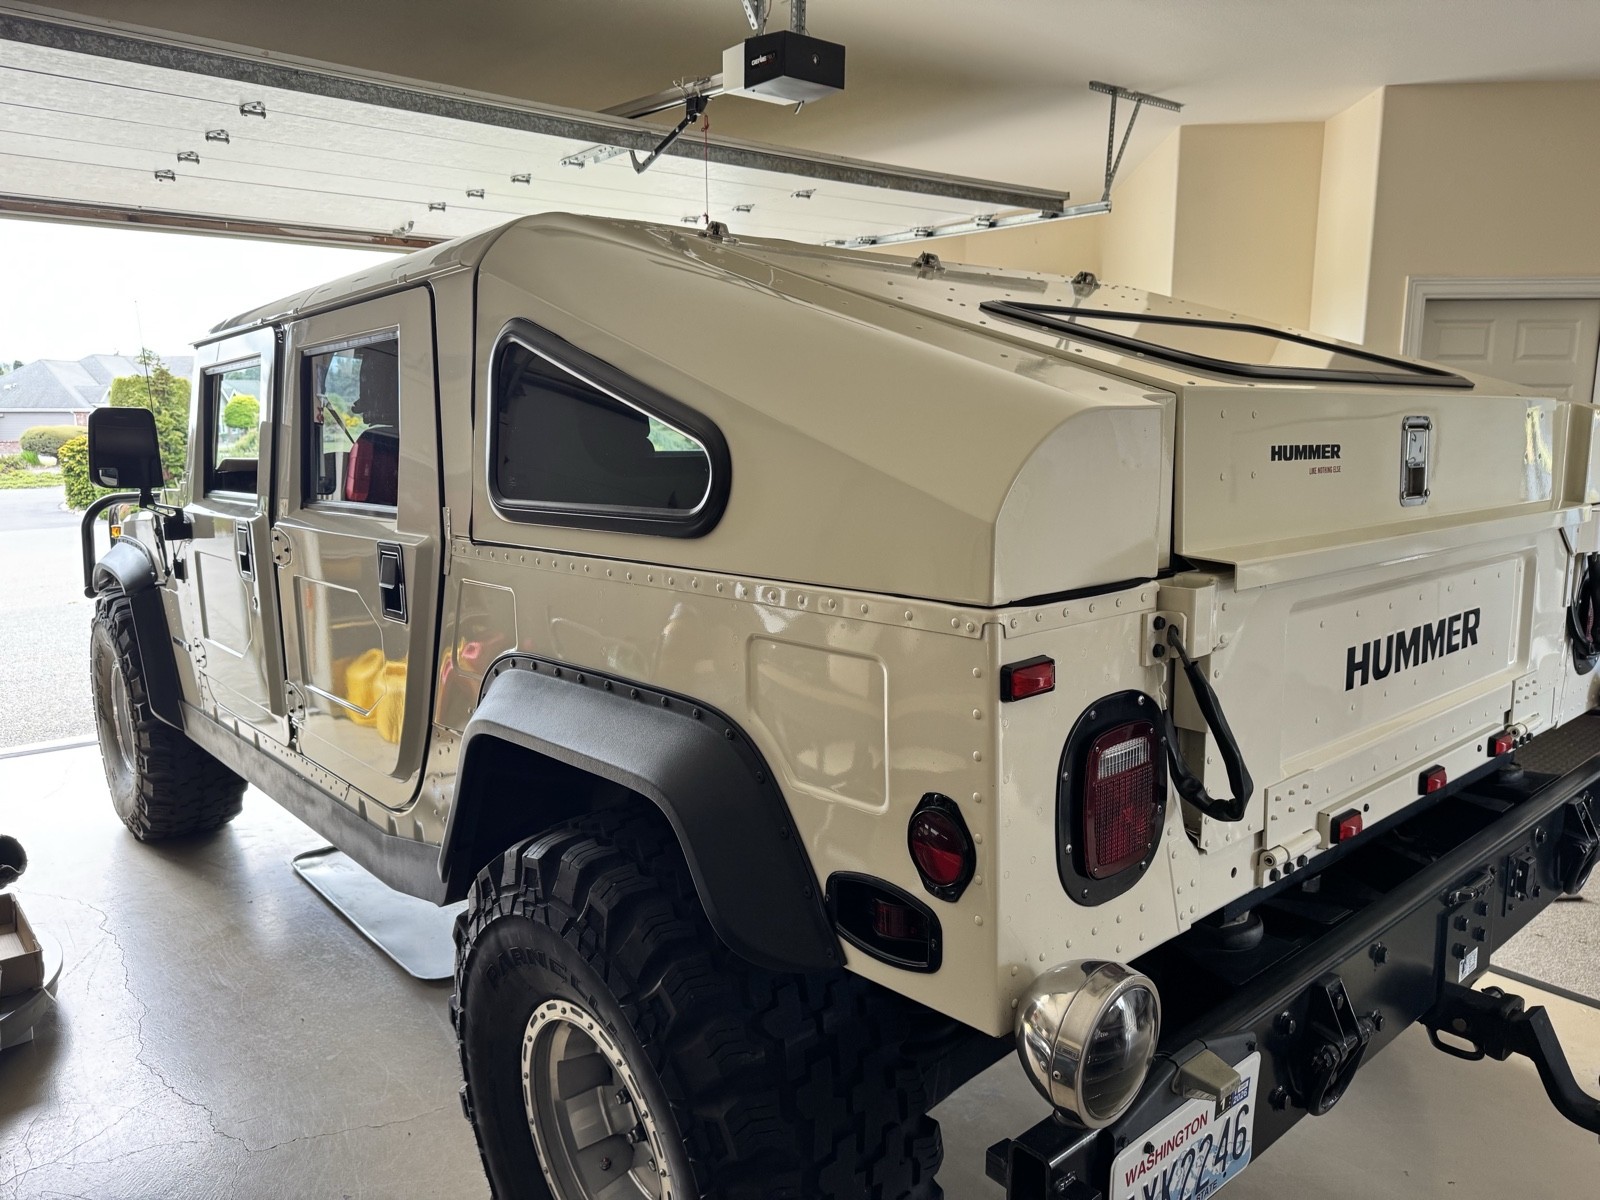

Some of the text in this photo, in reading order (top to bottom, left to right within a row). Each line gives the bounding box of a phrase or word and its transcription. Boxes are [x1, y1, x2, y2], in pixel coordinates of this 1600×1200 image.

[1270, 444, 1341, 461] HUMMER
[1317, 466, 1332, 474] NOTHING
[1333, 465, 1341, 473] ELSE
[1345, 607, 1481, 691] HUMMER
[1125, 1110, 1208, 1187] WASHINGTON
